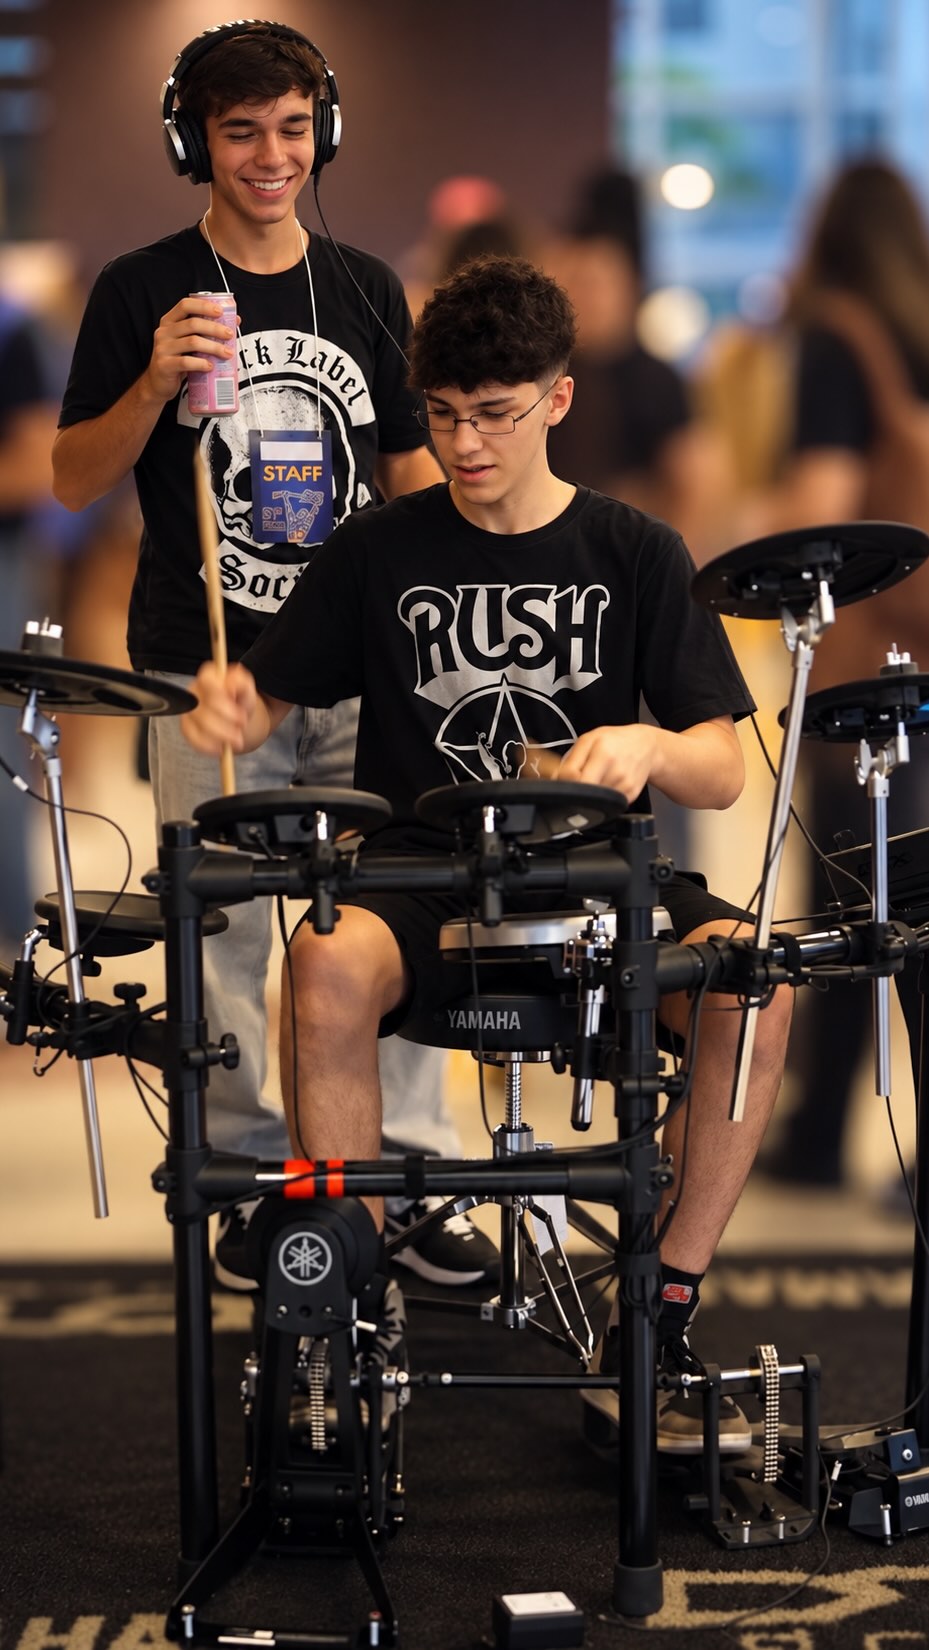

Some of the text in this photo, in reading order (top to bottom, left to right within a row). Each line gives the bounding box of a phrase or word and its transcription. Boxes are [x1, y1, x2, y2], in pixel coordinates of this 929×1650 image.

[284, 336, 367, 407] Label
[263, 465, 323, 482] STAFF
[397, 583, 611, 697] RUSH
[447, 1009, 521, 1030] YAMAHA
